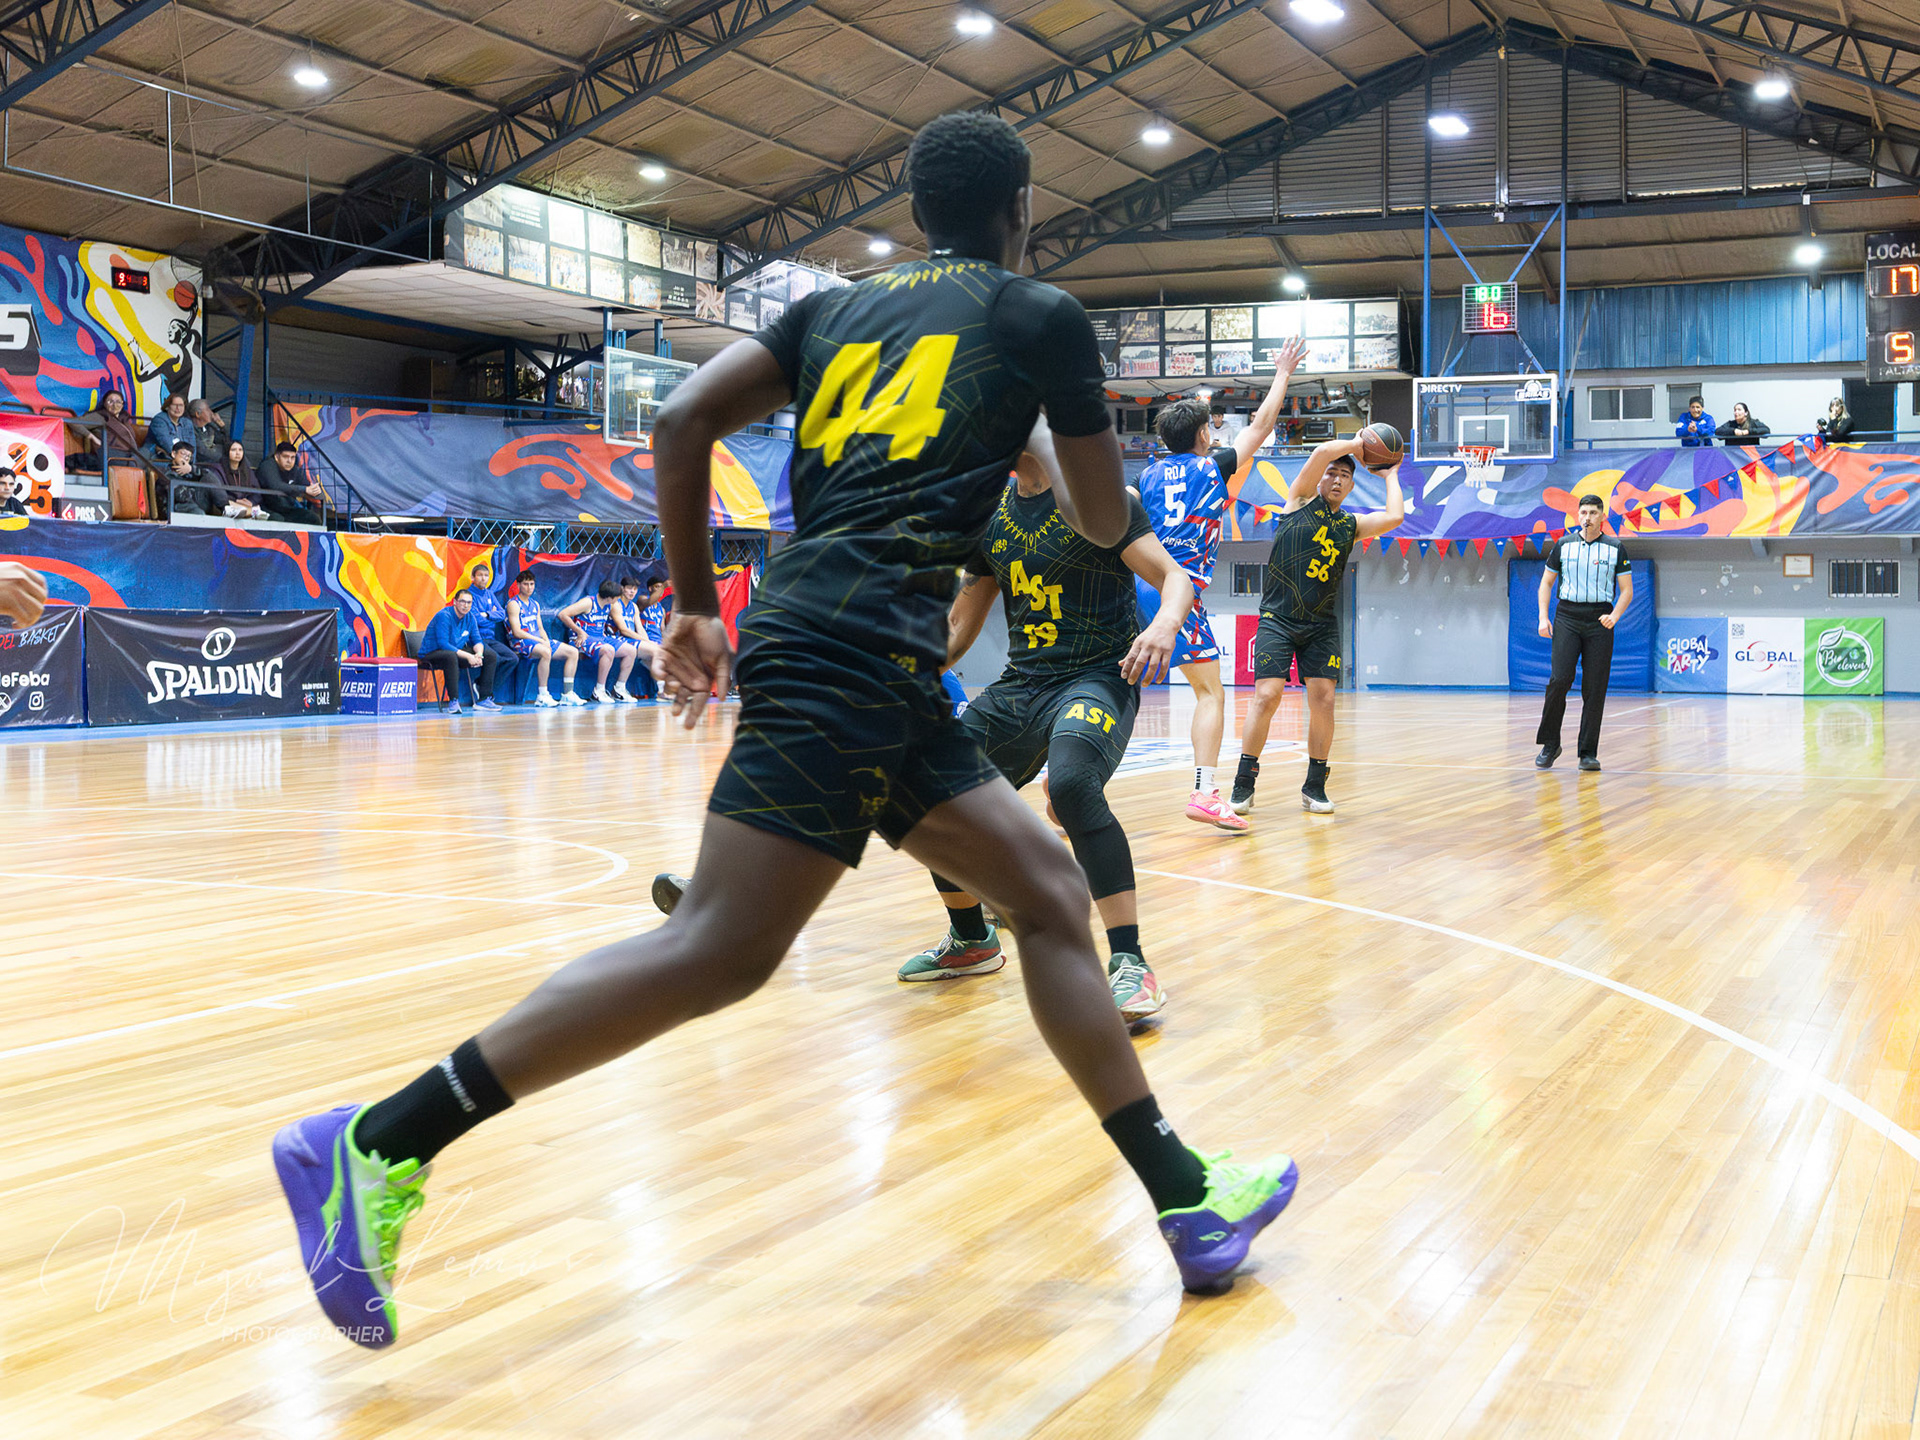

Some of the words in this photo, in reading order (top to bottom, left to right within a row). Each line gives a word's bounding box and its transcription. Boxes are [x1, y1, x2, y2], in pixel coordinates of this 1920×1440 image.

[1868, 242, 1920, 260] LOCAL
[1890, 266, 1918, 295] 17
[1482, 302, 1508, 328] 16
[1891, 333, 1912, 362] 5
[800, 334, 960, 468] 44
[1420, 384, 1462, 394] DIRECTV
[1164, 464, 1186, 481] ROA
[1163, 482, 1188, 527] 5
[1312, 525, 1340, 567] AST
[1305, 558, 1330, 583] 56
[1010, 560, 1063, 620] AST
[18, 622, 67, 648] BASKET
[1667, 635, 1711, 655] GLOBAL
[1667, 653, 1710, 674] PARTY
[1735, 650, 1797, 662] GLOBAL
[1838, 659, 1867, 672] eleven
[0, 671, 50, 687] eFeba
[146, 656, 283, 704] SPALDING
[1065, 704, 1116, 734] AST
